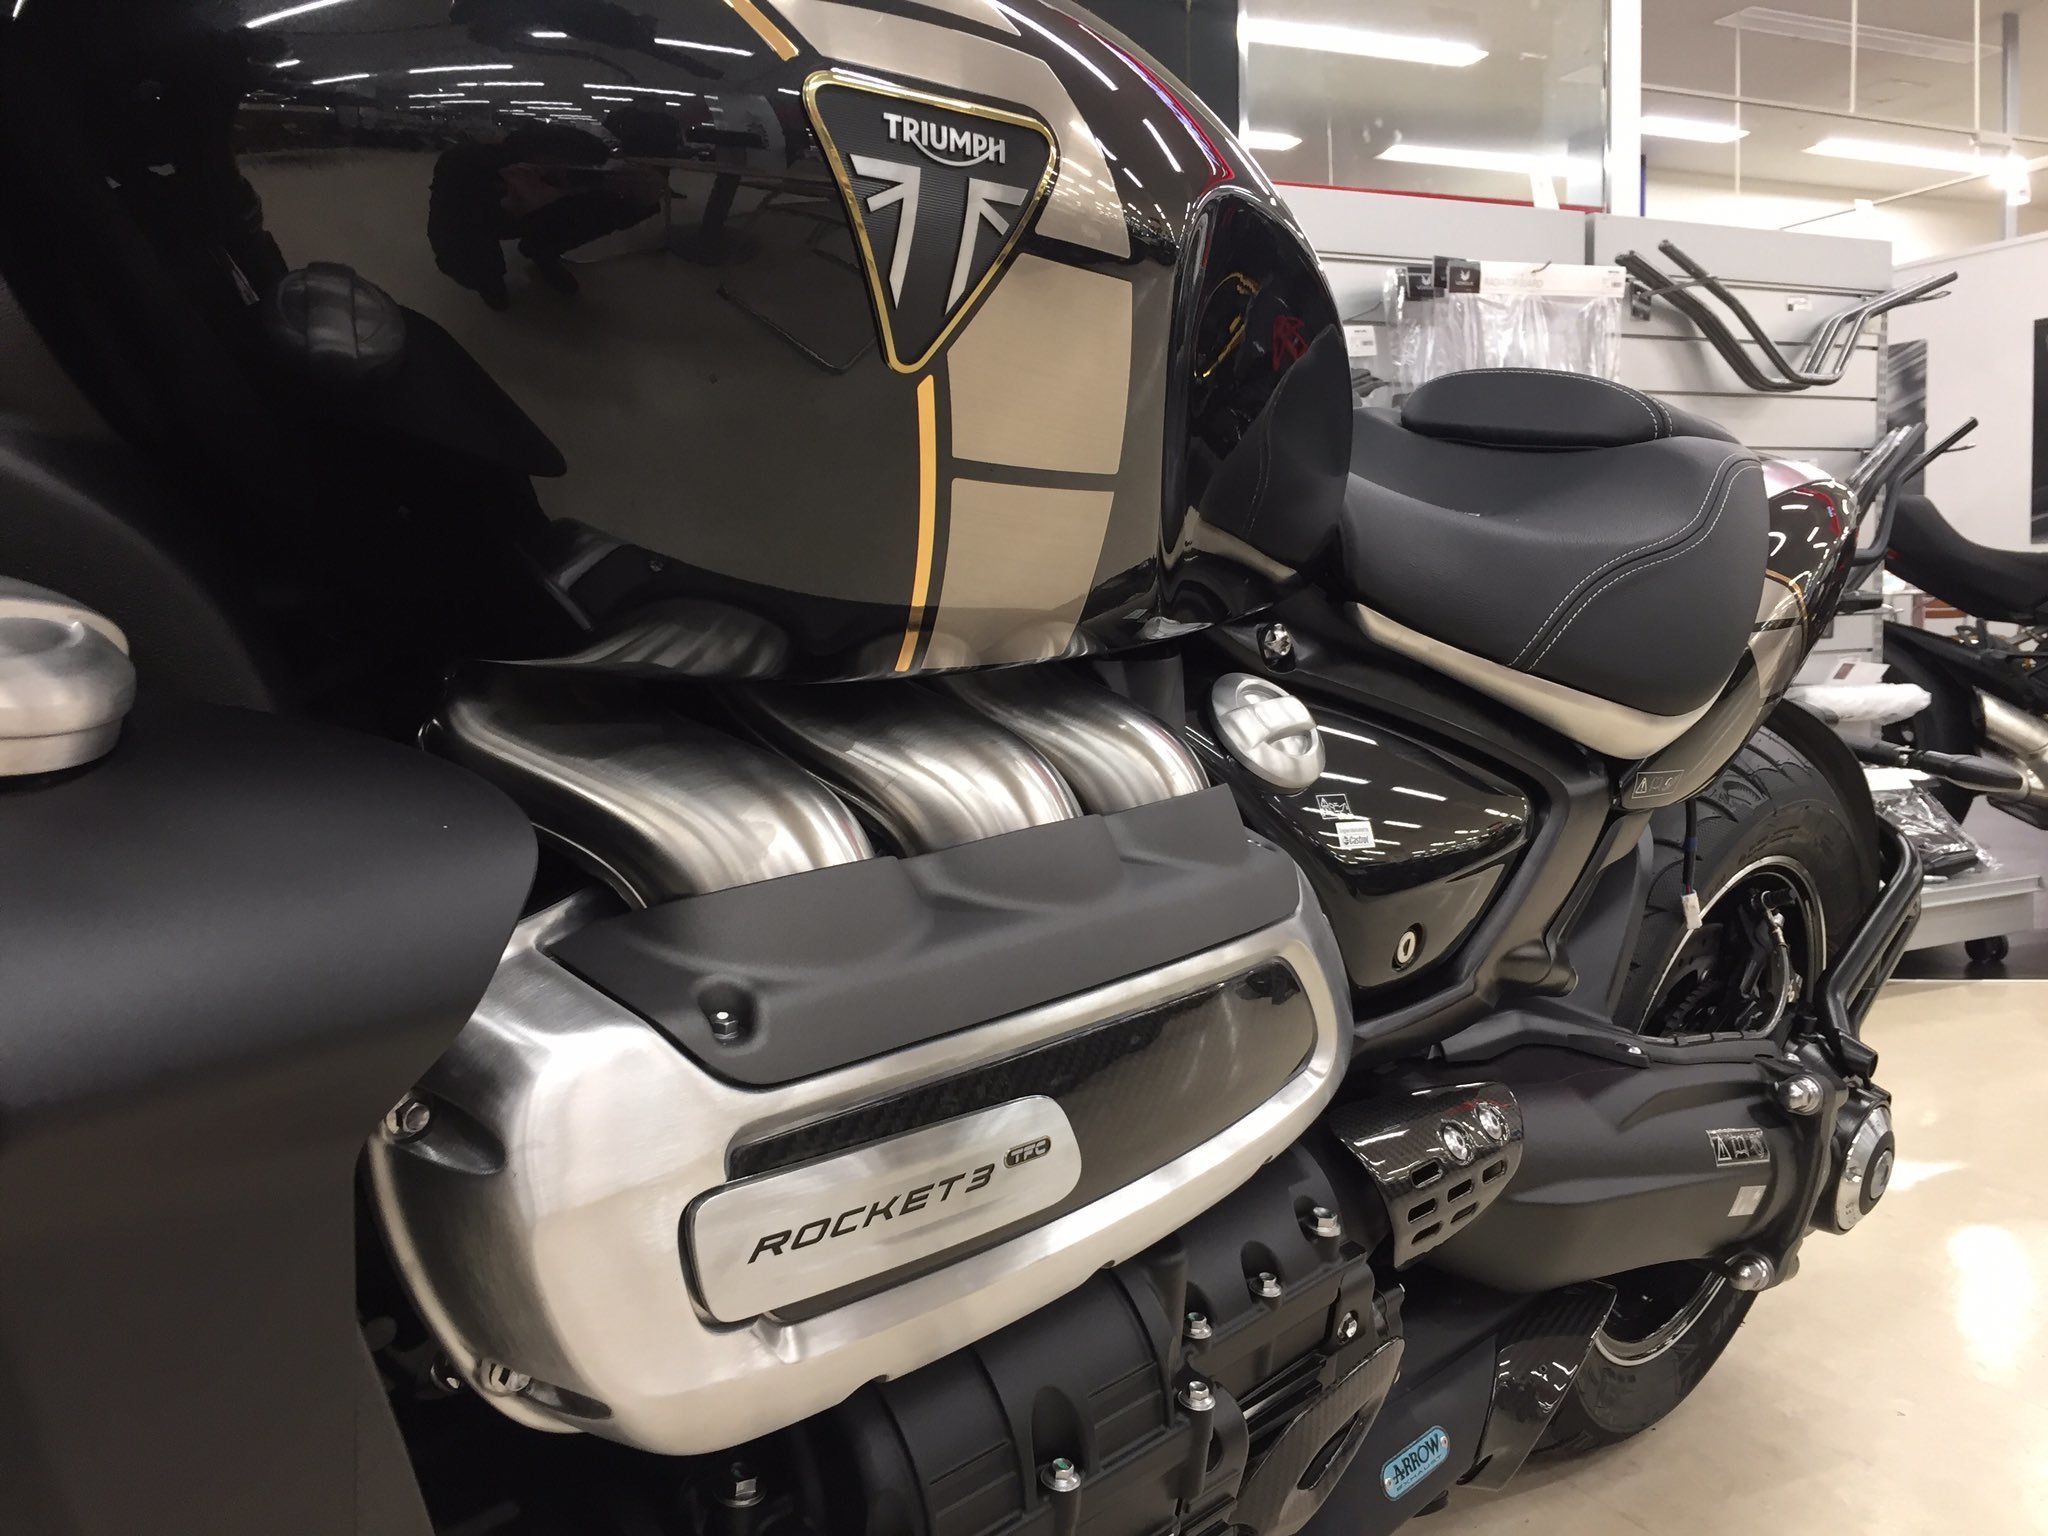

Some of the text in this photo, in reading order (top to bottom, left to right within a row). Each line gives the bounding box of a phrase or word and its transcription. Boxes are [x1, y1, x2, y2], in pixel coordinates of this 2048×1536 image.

[883, 112, 1006, 167] TRIUMPH
[1010, 1139, 1047, 1164] TFC
[1392, 1432, 1440, 1485] ARROW
